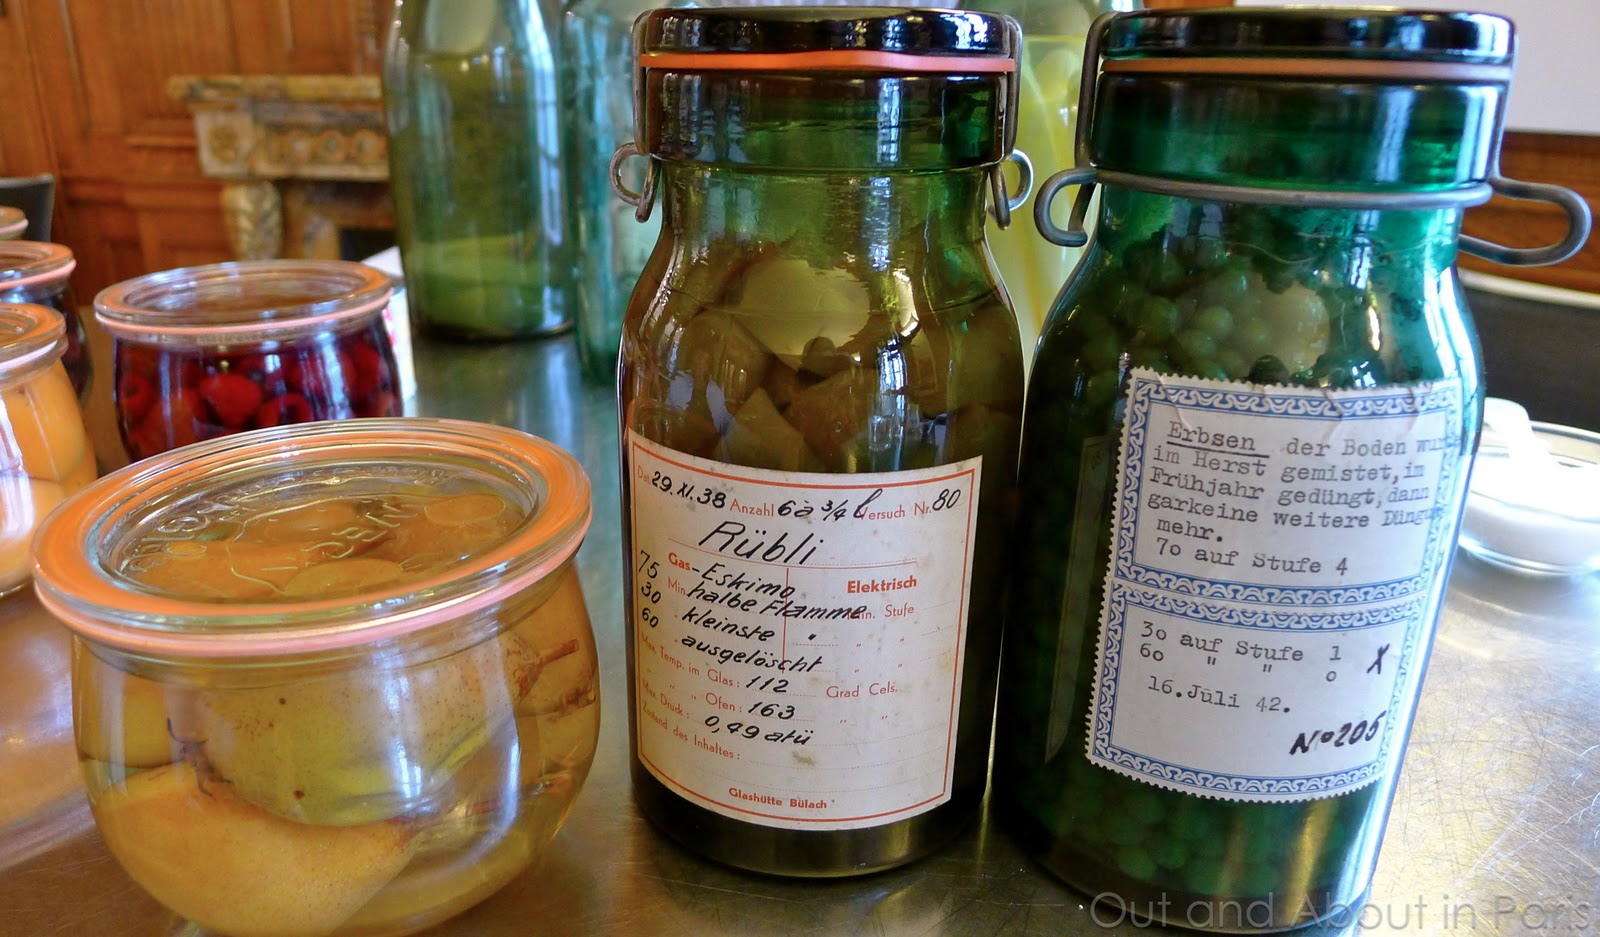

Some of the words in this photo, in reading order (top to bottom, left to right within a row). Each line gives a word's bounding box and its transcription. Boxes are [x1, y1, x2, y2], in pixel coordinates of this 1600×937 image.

[1166, 421, 1256, 451] Erbsen
[1286, 438, 1331, 457] der
[1341, 439, 1407, 457] Boden
[1153, 446, 1180, 465] im
[1192, 451, 1267, 476] Herst
[1150, 466, 1265, 499] Frühjahr
[729, 498, 775, 518] Anzahl
[914, 501, 932, 516] Nr.
[932, 488, 961, 511] 80
[1147, 494, 1258, 522] garkeine
[1273, 512, 1370, 528] weitere
[698, 520, 824, 565] Rübli
[1156, 518, 1223, 543] mehr.
[639, 549, 660, 579] 75
[1194, 549, 1239, 566] auf
[1252, 553, 1321, 573] Stufe
[1336, 557, 1348, 576] 4
[641, 581, 662, 605] 30
[847, 575, 918, 594] Elektrisch
[687, 580, 757, 611] halbe
[759, 599, 868, 621] Flamme
[884, 602, 915, 618] Stufe
[641, 607, 660, 628] 60
[681, 606, 776, 642] kleinste
[681, 635, 823, 673] ausgelöscht
[1180, 634, 1223, 653] auf
[1235, 640, 1304, 661] Stufe
[660, 644, 686, 670] Temp.
[688, 662, 700, 677] im
[745, 675, 789, 694] 112
[826, 684, 860, 699] Grad
[868, 681, 898, 696] Cels.
[748, 701, 796, 720] 163
[1255, 696, 1291, 713] 42.
[673, 726, 689, 742] des
[728, 787, 783, 806] Glashütte
[789, 798, 828, 809] Bülach
